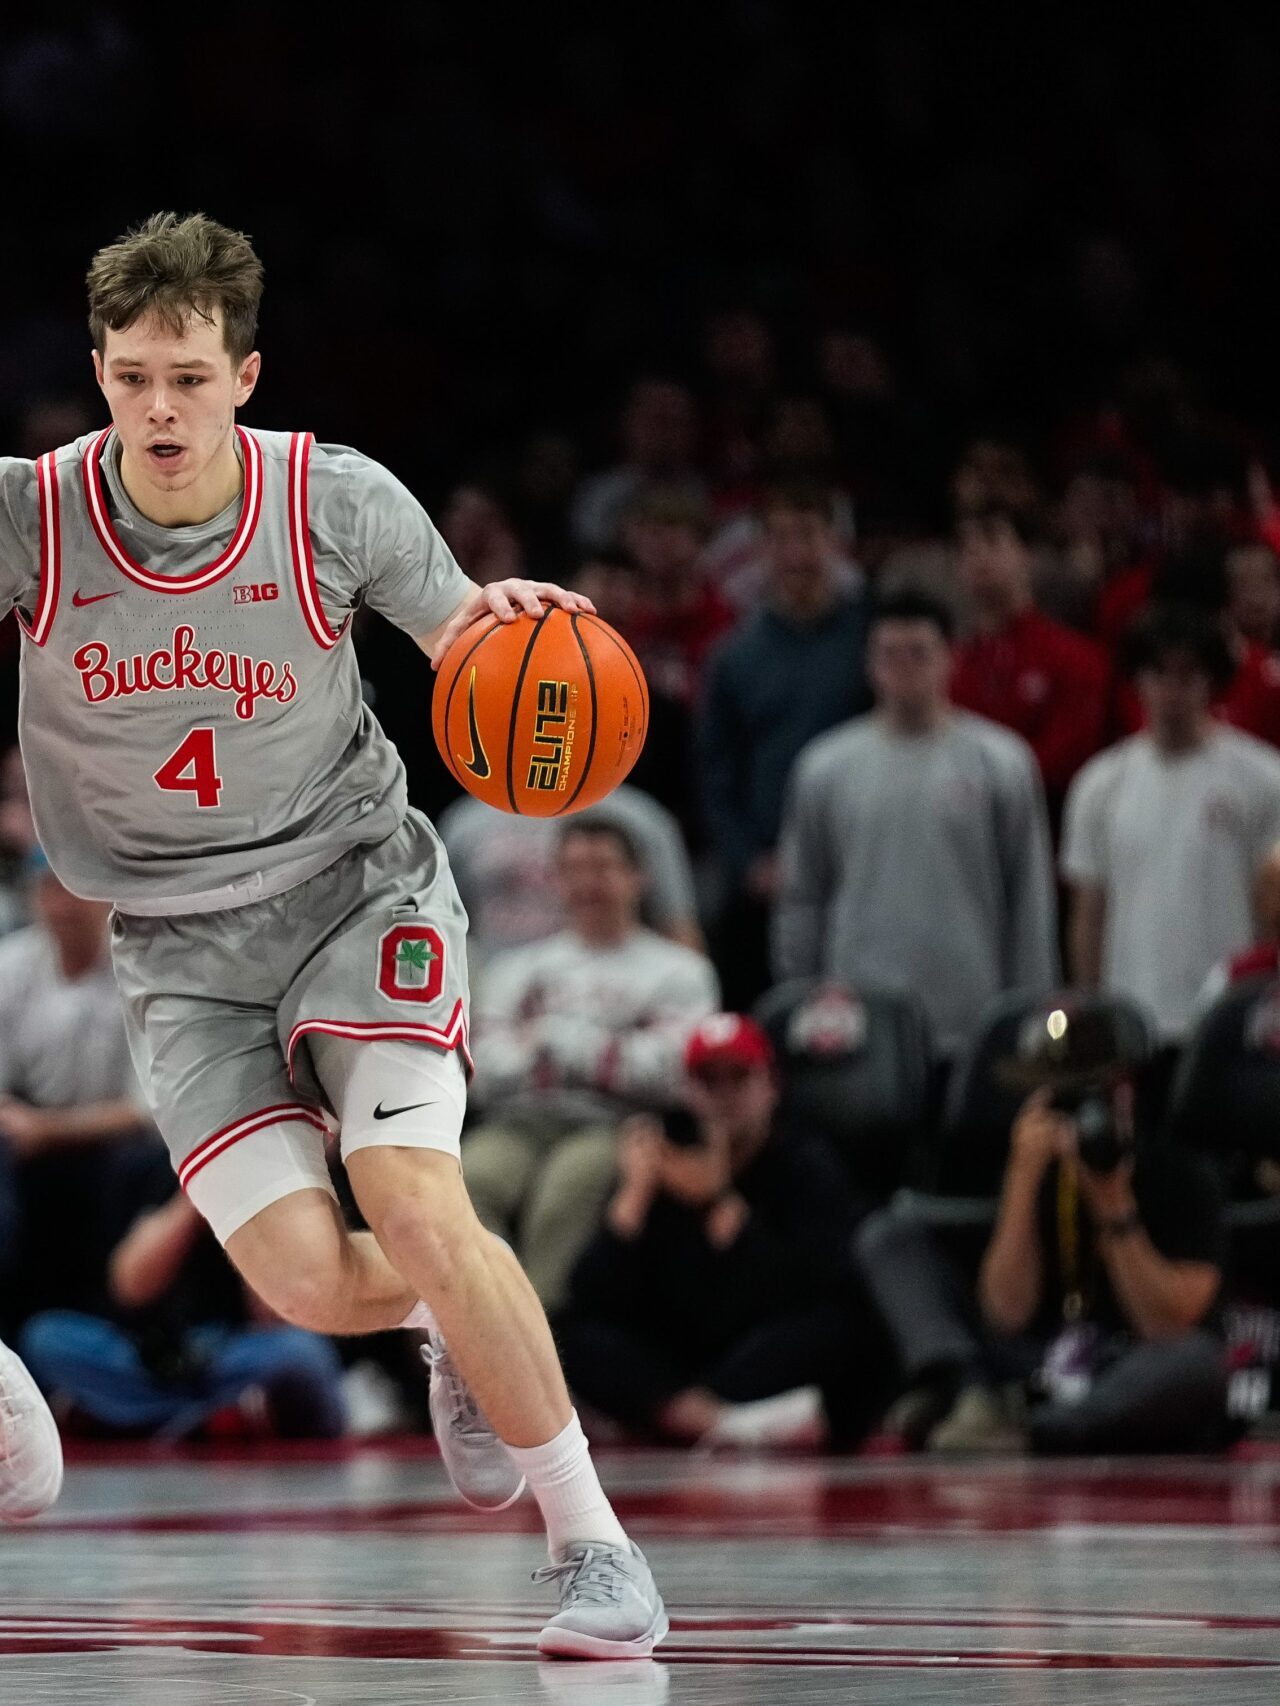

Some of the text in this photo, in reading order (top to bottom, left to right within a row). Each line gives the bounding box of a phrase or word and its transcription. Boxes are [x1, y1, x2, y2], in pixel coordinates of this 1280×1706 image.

[73, 624, 298, 720] Buckeyes
[152, 727, 223, 808] 4
[526, 680, 569, 791] ELITE
[558, 683, 579, 792] CHAMPIONSP
